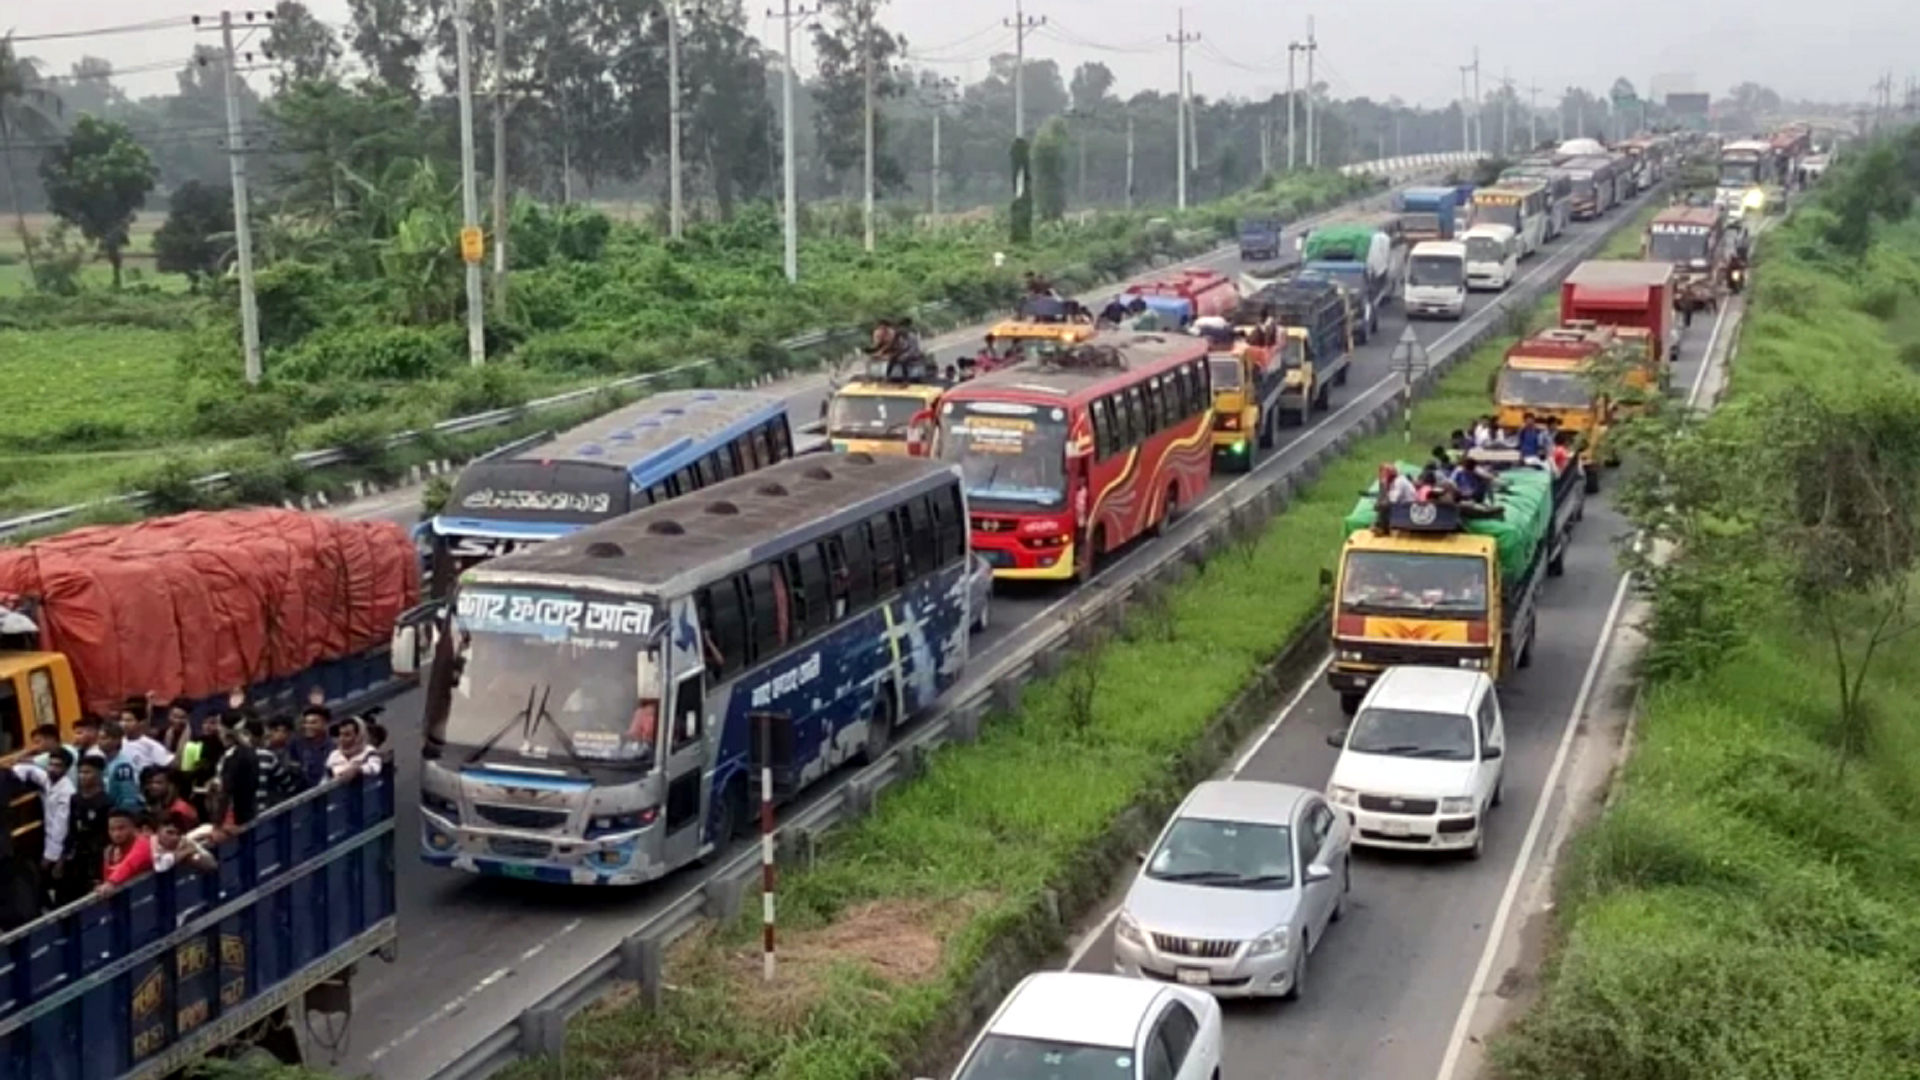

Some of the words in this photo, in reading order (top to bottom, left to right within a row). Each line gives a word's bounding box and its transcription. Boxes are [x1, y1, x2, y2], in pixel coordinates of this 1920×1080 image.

[1652, 223, 1710, 235] HANIF
[508, 596, 584, 633] ফতেহ
[584, 601, 654, 635] আলী
